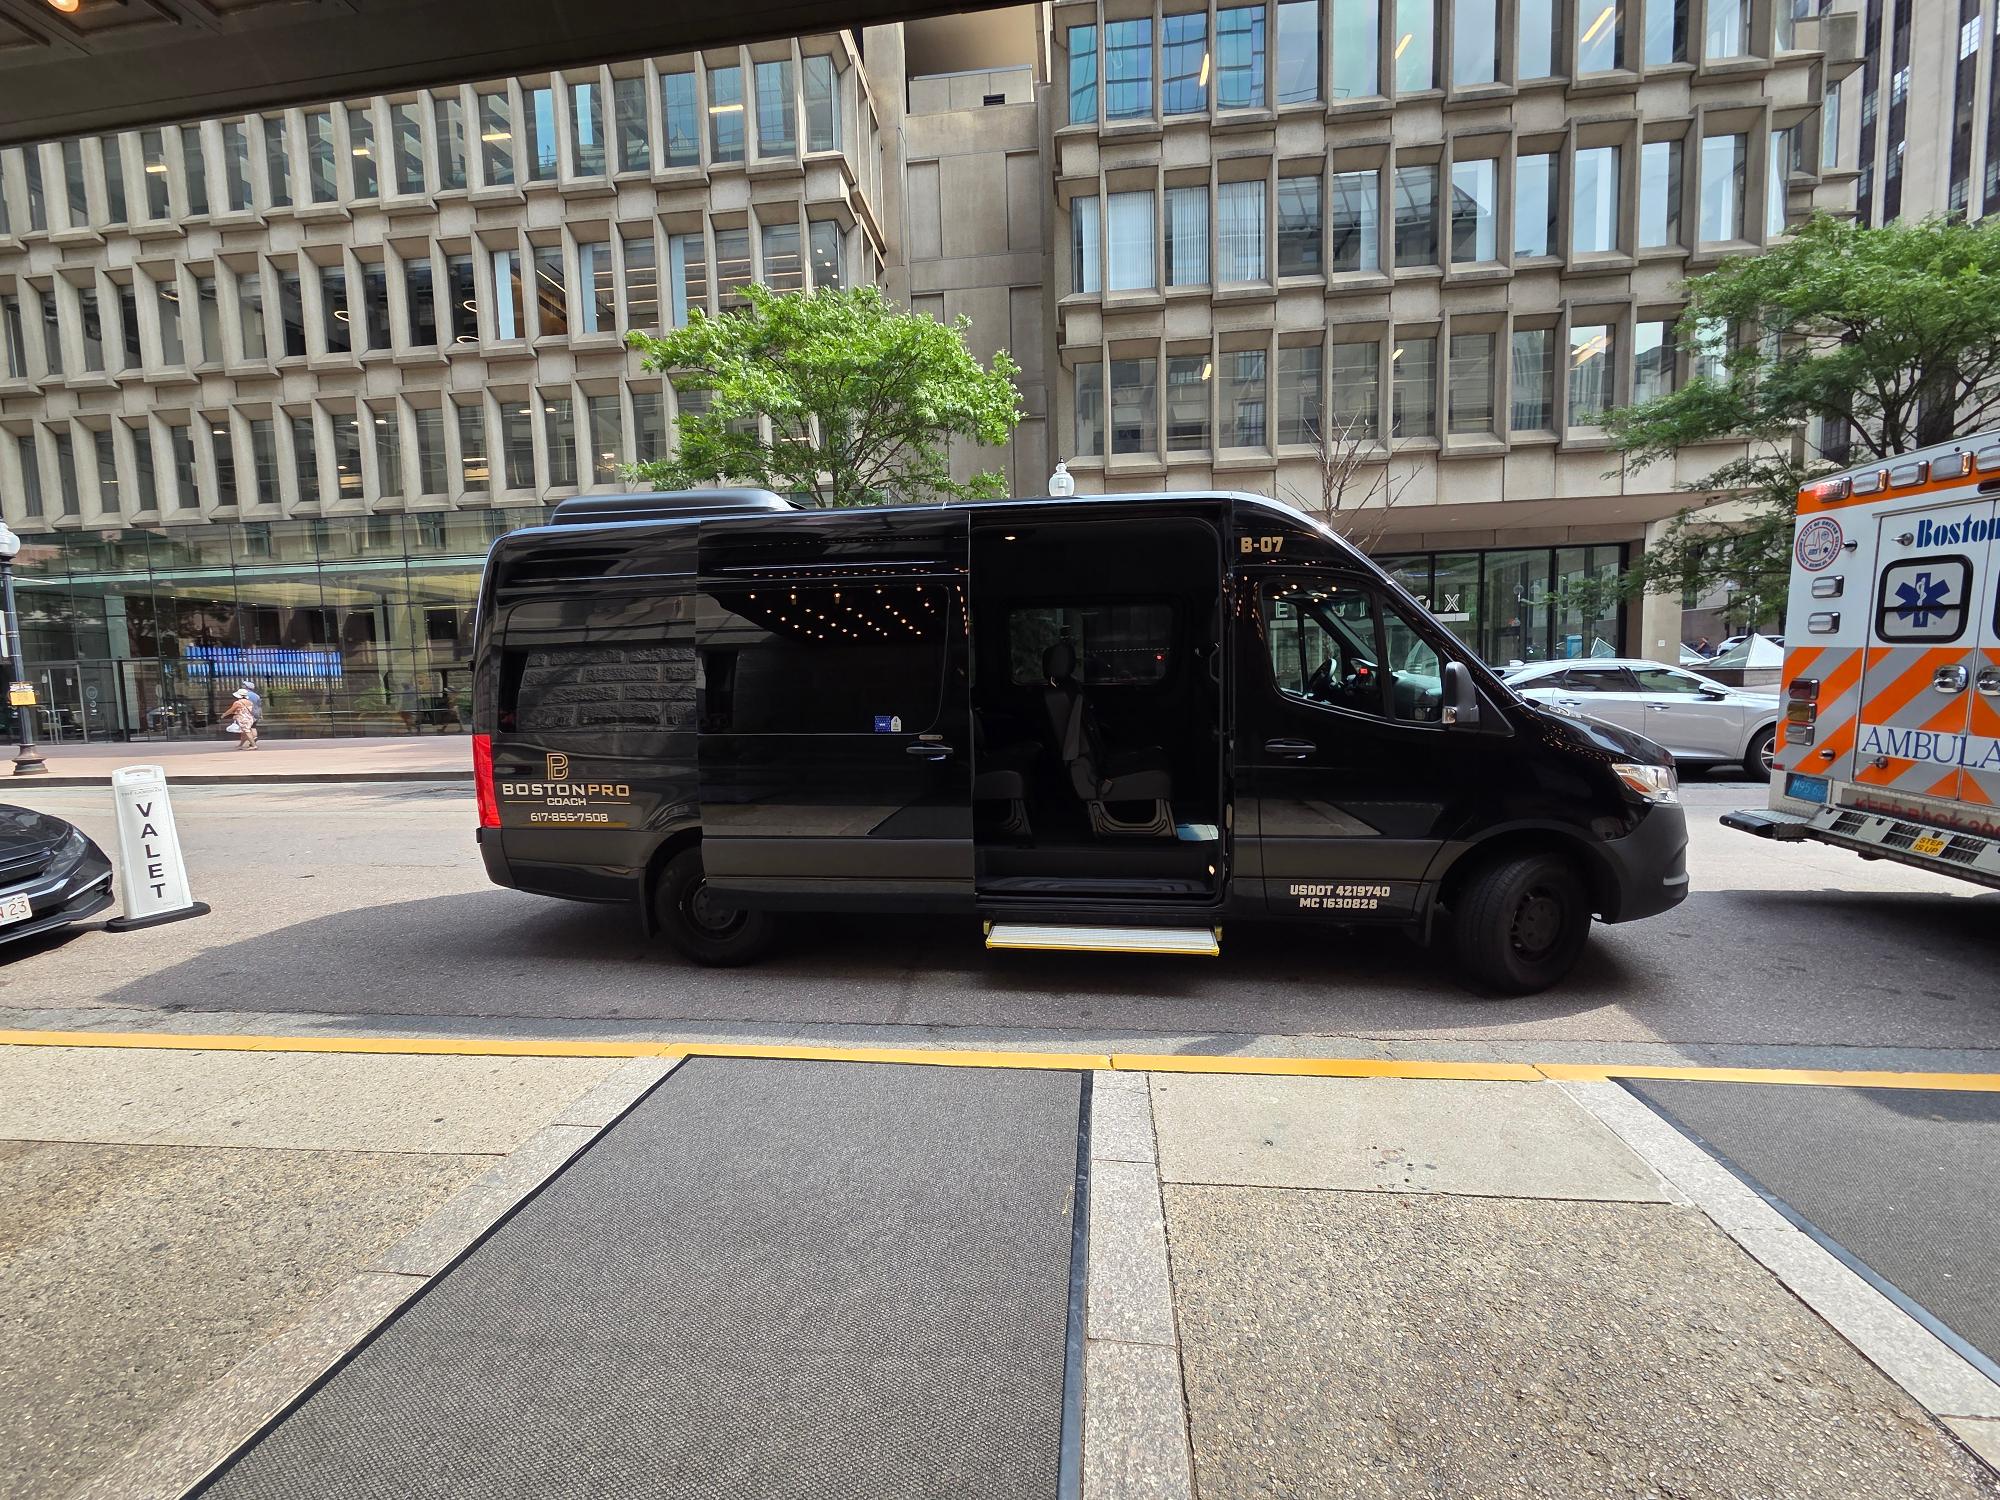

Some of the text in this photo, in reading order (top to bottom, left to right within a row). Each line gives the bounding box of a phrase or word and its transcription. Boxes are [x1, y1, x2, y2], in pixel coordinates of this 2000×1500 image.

[1240, 536, 1284, 553] B-07
[547, 797, 587, 806] COACH
[530, 812, 609, 823] 617-855-7508
[1919, 837, 1944, 847] STEP
[136, 802, 166, 899] VALET
[1914, 844, 1939, 854] IS UP
[1290, 884, 1391, 897] USDOT 4219740
[1299, 897, 1378, 909] MC 1630828
